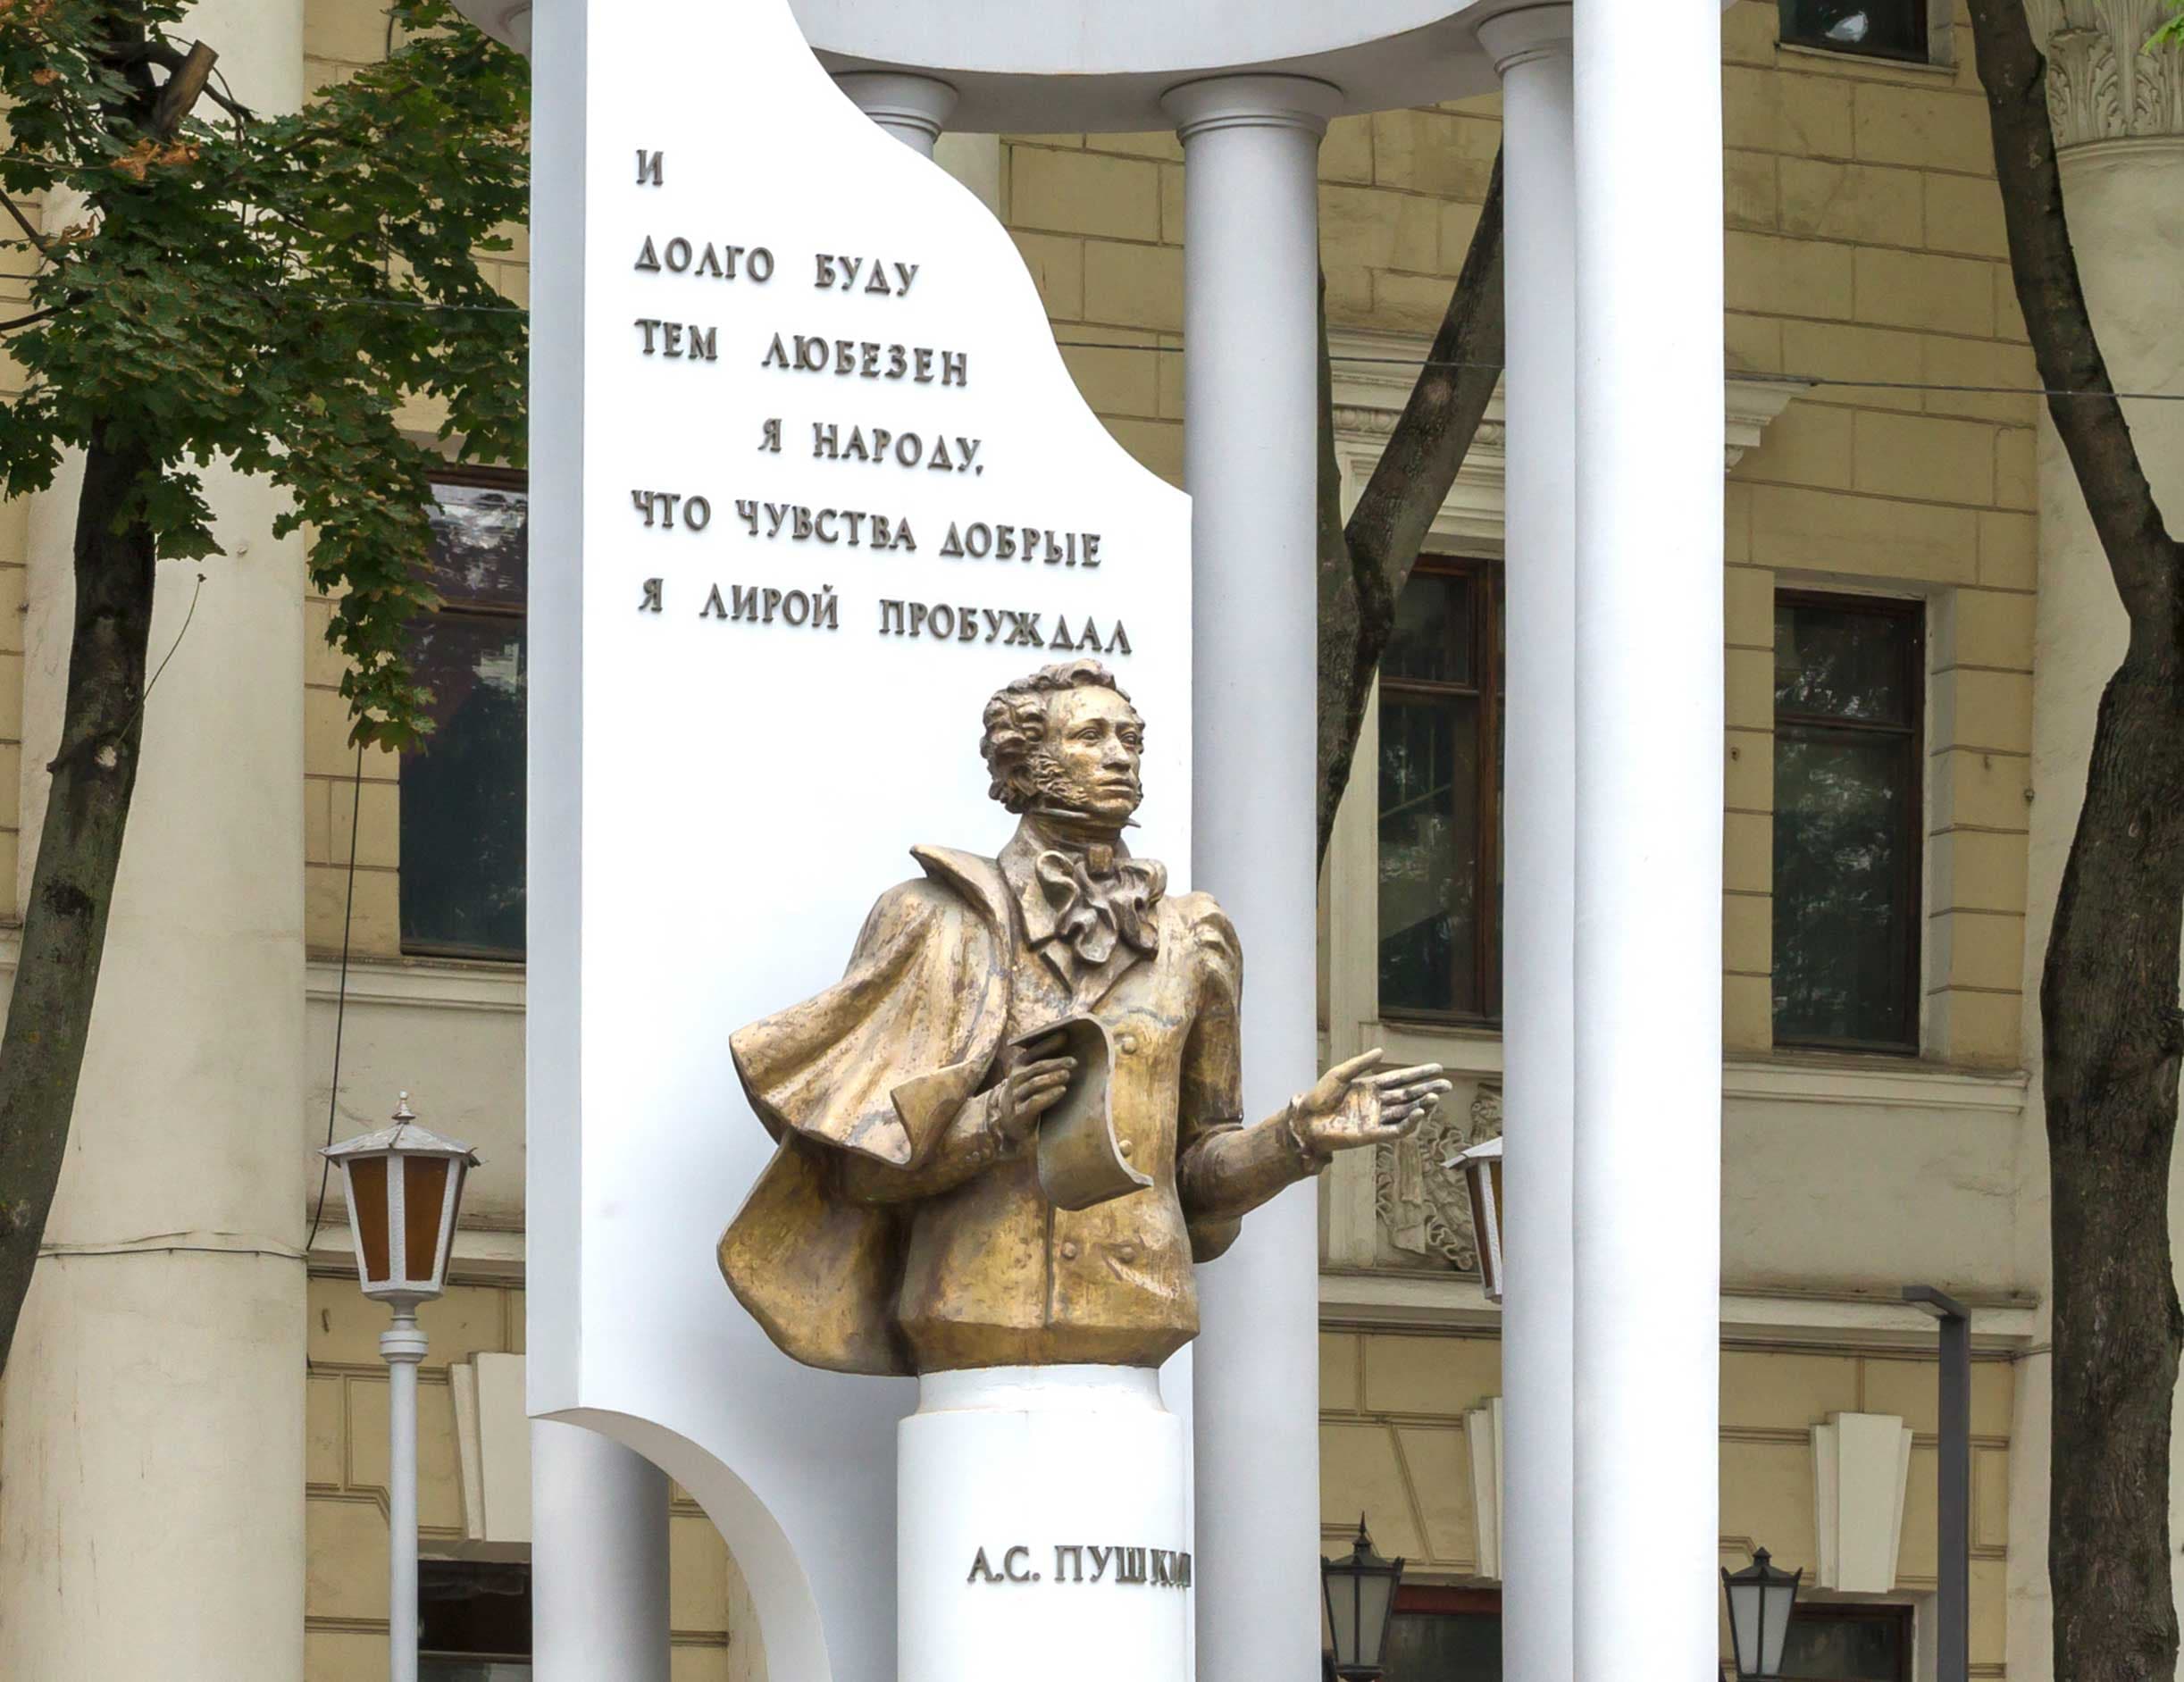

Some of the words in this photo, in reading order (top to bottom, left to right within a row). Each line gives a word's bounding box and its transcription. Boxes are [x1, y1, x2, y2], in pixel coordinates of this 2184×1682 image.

[637, 150, 663, 186] И
[633, 235, 774, 284] ДОЛГО
[814, 253, 919, 297] БУДУ
[633, 318, 718, 362] ТЕМ
[761, 332, 967, 388] ЛЮБЕЗЕН
[757, 418, 782, 453] Я
[631, 490, 711, 532] ЧТО
[735, 499, 917, 552] ЧУВСТВА
[939, 522, 1101, 569] ДОБРЫЕ
[638, 578, 664, 614] Я
[699, 583, 839, 631] ЛИРОЙ
[878, 598, 1133, 656] ПРОБУЖДАЛ
[1054, 1545, 1192, 1588] ПУШКИ
